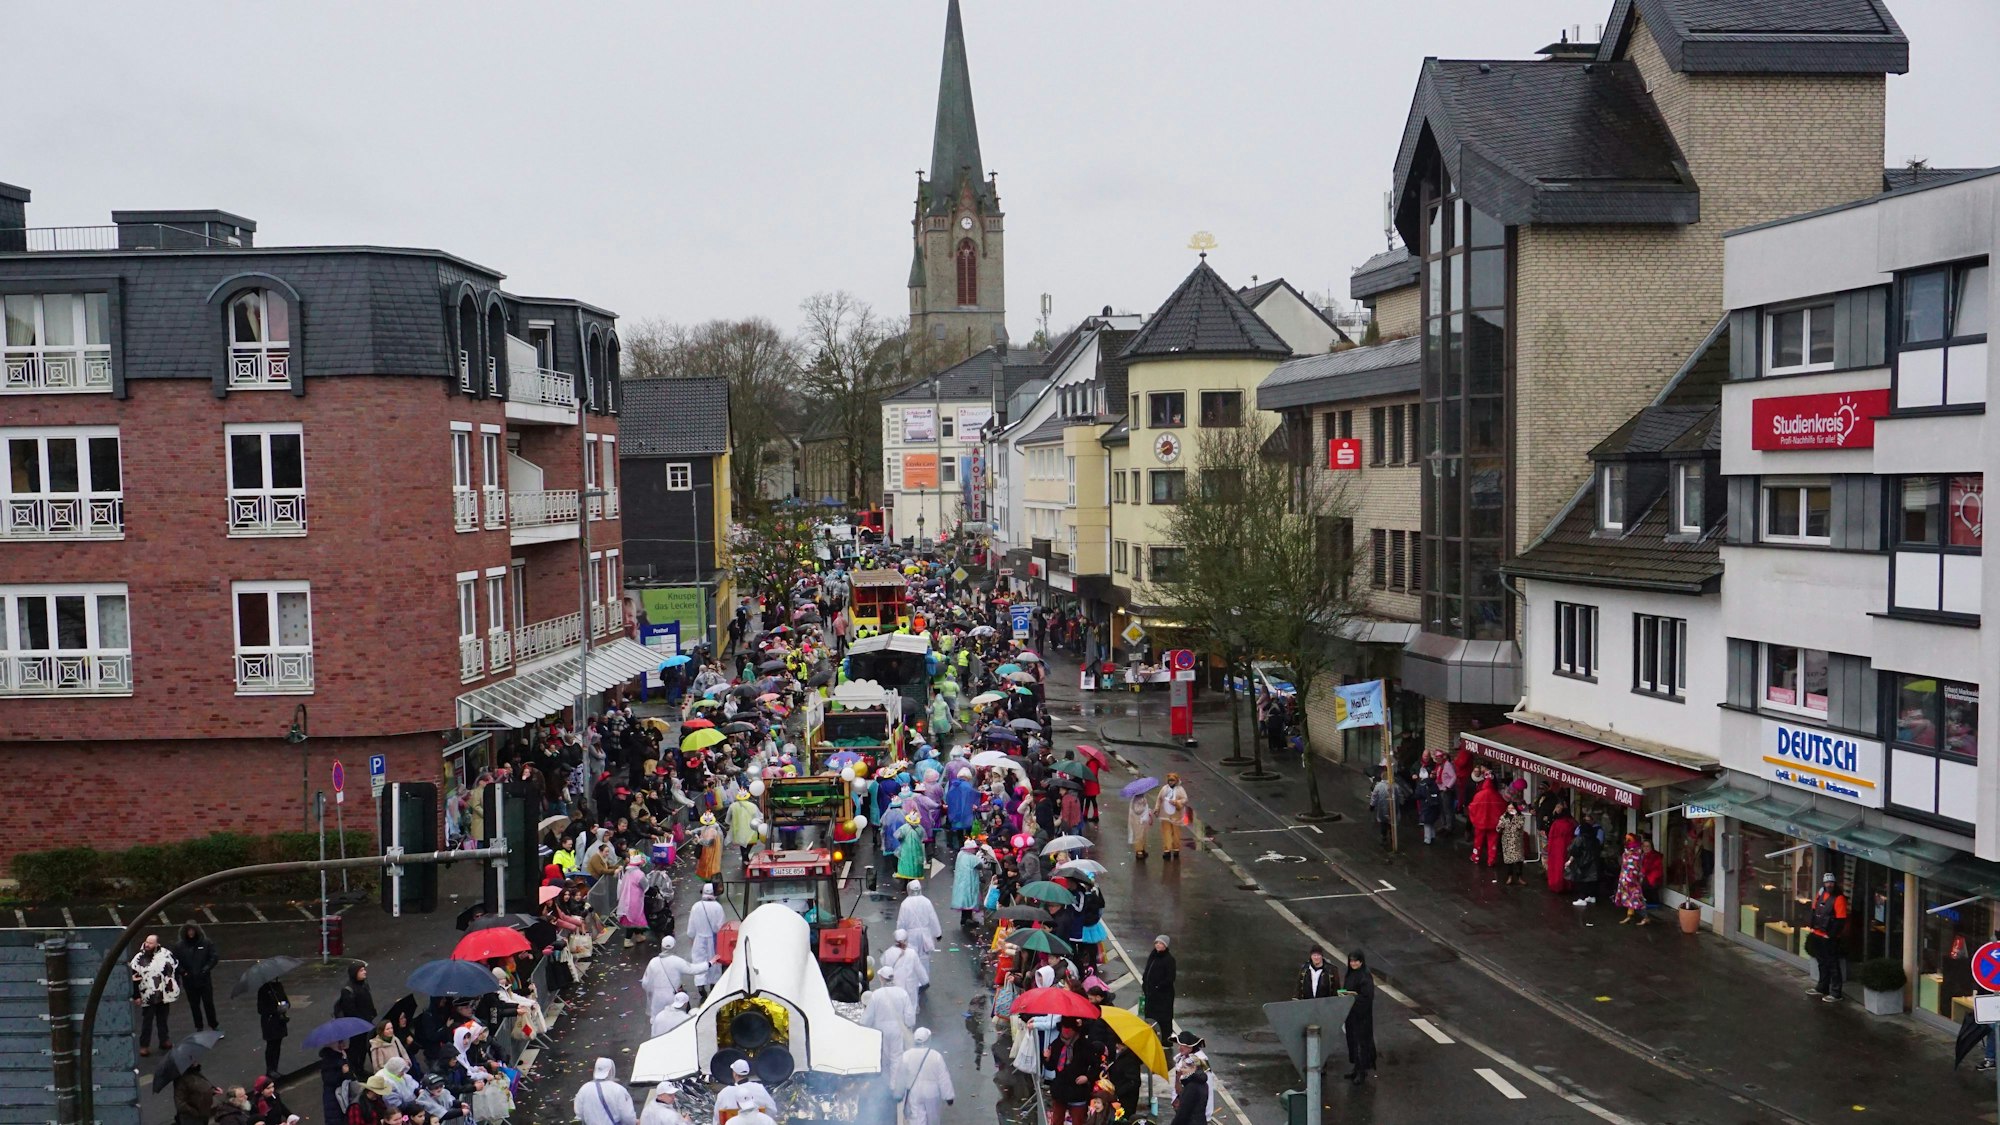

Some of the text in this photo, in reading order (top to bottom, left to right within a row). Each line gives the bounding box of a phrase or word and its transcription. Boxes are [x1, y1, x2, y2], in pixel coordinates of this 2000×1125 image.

[1773, 412, 1844, 435] Studienkreis
[972, 447, 980, 519] APOTHEKE
[654, 602, 668, 610] das
[668, 593, 697, 601] Knuspe
[1778, 727, 1857, 773] DEUTSCH
[372, 757, 382, 774] P
[1464, 740, 1633, 806] TARA AKTUELLE & KLASSISCHE DAMENMODE TARA
